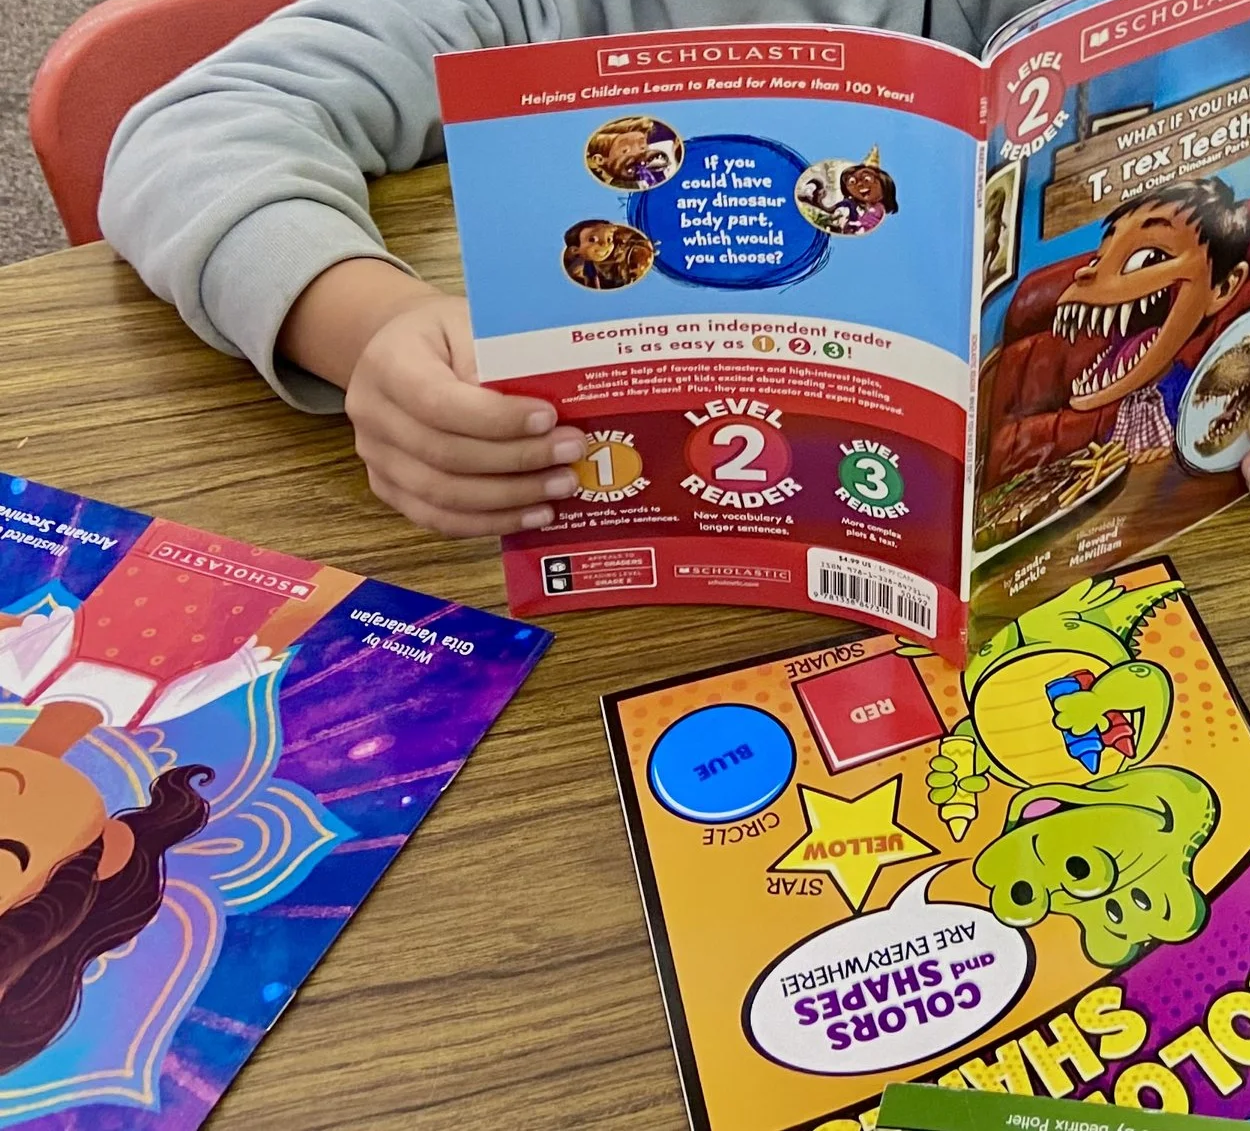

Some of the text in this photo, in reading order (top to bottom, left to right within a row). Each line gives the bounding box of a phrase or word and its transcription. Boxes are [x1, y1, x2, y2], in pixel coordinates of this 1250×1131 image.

[636, 46, 837, 66] SCHOLASTIC
[1007, 51, 1063, 95] LEVEL
[521, 77, 915, 106] Helping Children Learn to Read for More than 100 Years!
[1018, 75, 1051, 138] 2
[1000, 109, 1070, 163] READER
[1117, 118, 1166, 151] WHAT
[1169, 112, 1184, 131] IF
[1188, 96, 1222, 122] YOU
[704, 154, 756, 174] If you
[1088, 166, 1113, 204] T.
[1121, 144, 1173, 182] rex
[1120, 139, 1250, 202] And Other Dinosaur Parts
[681, 172, 772, 190] could have
[677, 191, 786, 213] any dinosaur
[680, 211, 773, 232] body part,
[683, 229, 784, 246] which would
[685, 247, 784, 270] you choose?
[571, 319, 893, 350] Becoming an independent reader
[618, 342, 633, 355] is
[640, 341, 662, 353] as
[669, 340, 716, 353] easy
[723, 339, 745, 350] as
[577, 374, 891, 403] Scholastic Readers get kids excited about reading and feeling
[584, 364, 882, 389] With the help of favorite characters and high-interest topics,
[612, 390, 625, 398] as
[627, 386, 650, 397] they
[652, 384, 682, 395] learn!
[687, 384, 712, 394] Plus,
[714, 384, 737, 394] they
[739, 385, 756, 393] are
[758, 386, 801, 397] educator
[803, 389, 823, 400] and
[825, 392, 856, 405] expert
[857, 397, 905, 417] approved.
[684, 397, 783, 430] LEVEL
[585, 430, 635, 448] EVEL
[712, 423, 768, 482] 2
[587, 445, 615, 487] 1
[839, 439, 901, 469] LEVEL
[680, 473, 803, 509] READER
[854, 457, 889, 500] 3
[559, 512, 583, 521] Sight
[586, 508, 618, 518] words,
[619, 506, 649, 515] words
[834, 486, 911, 519] READER
[571, 521, 587, 529] out
[589, 519, 597, 527] &
[600, 516, 630, 528] simple
[693, 511, 795, 525] New vocabulary &
[699, 522, 790, 536] longer sentences.
[841, 517, 902, 540] More complex
[0, 528, 69, 557] Illustrated
[56, 523, 118, 551] Archana
[846, 528, 898, 548] plots & text.
[1078, 528, 1119, 552] Howard
[1014, 550, 1051, 583] Sandra
[1069, 539, 1123, 568] McWilliam
[157, 546, 290, 592] SCHOLASTIC
[692, 567, 789, 581] SCHOLASTIC
[1008, 565, 1047, 597] Markle
[350, 608, 476, 657] Gita Varadarajan
[362, 632, 434, 667] Written by
[785, 641, 867, 679] SQUARE
[849, 696, 896, 725] RED
[692, 742, 754, 783] BLUE
[702, 811, 782, 846] CIRCLE
[801, 833, 905, 861] YELLOW
[766, 877, 824, 897] STAR
[780, 921, 977, 998] ARE EVERYWHERE!
[793, 951, 996, 1026] and SHAPES
[827, 983, 983, 1052] COLORS
[1005, 1113, 1050, 1131] Potter
